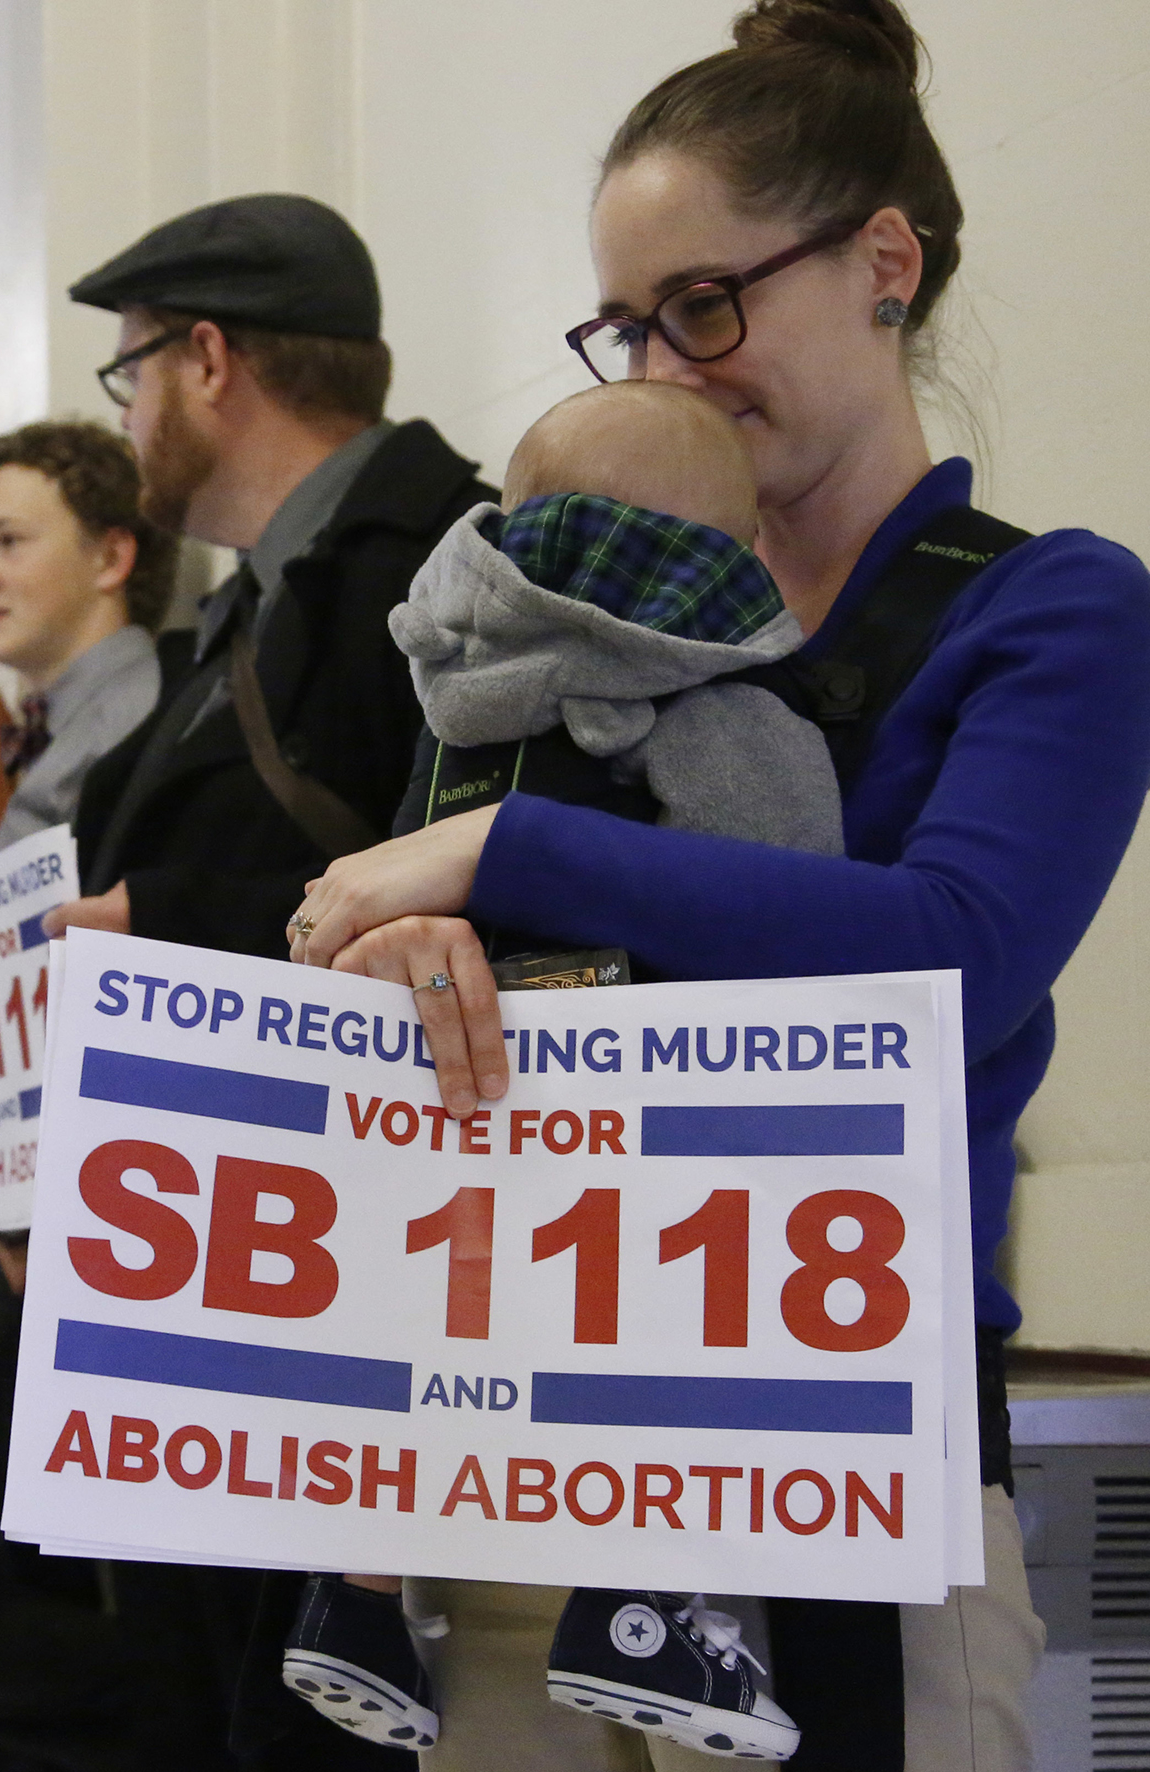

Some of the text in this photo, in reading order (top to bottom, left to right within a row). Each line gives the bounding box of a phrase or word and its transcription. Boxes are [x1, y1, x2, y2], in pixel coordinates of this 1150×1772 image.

[94, 970, 911, 1074] STOP REGULING MURDER
[344, 1092, 627, 1155] VOTE FOR
[66, 1139, 911, 1353] SB 1118
[420, 1373, 519, 1412] AND
[44, 1409, 904, 1539] ABOLISH ABORTION
